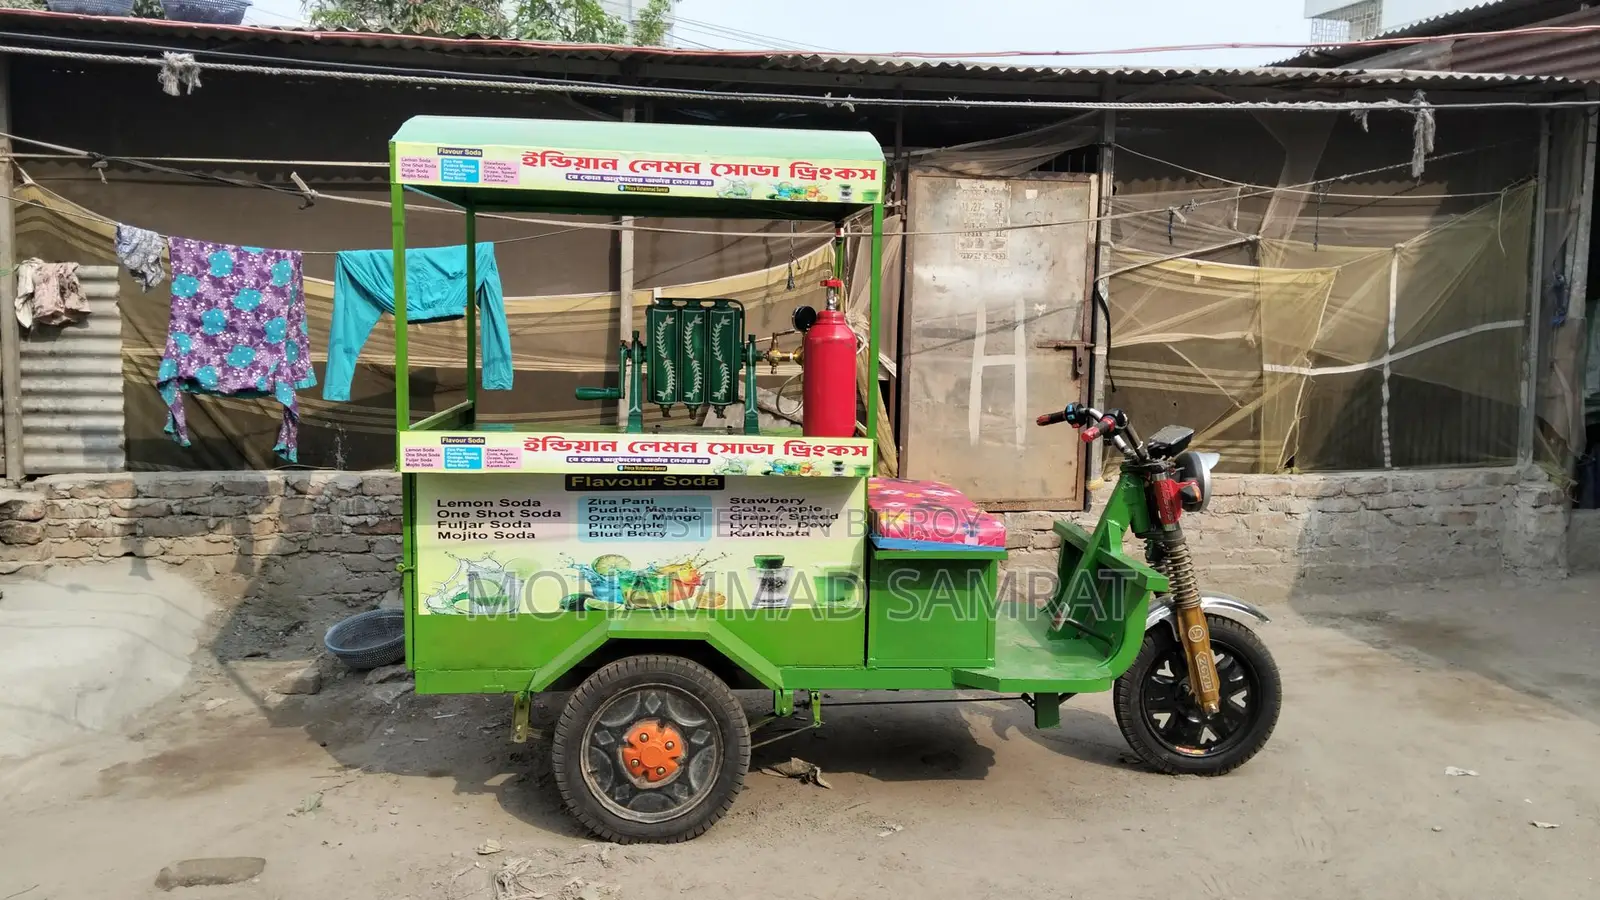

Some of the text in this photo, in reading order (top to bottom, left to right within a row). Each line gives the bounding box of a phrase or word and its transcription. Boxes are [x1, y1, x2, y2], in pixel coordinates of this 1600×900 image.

[522, 151, 877, 180] ইন্ডিয়ান লেমন সোডা ড্রিংকস
[523, 436, 868, 457] ইন্ডিয়ান লেমন সোডা ড্রিংকস
[571, 476, 719, 487] Flavour Soda
[437, 499, 541, 507] Lemon Soda
[729, 497, 805, 505] Stawbery
[437, 509, 562, 518] One Shot Soda
[729, 505, 822, 513] Cola, Apple
[438, 520, 532, 530] Fuljar Soda
[588, 522, 665, 530] PineApple
[438, 531, 536, 541] Mojito Soda
